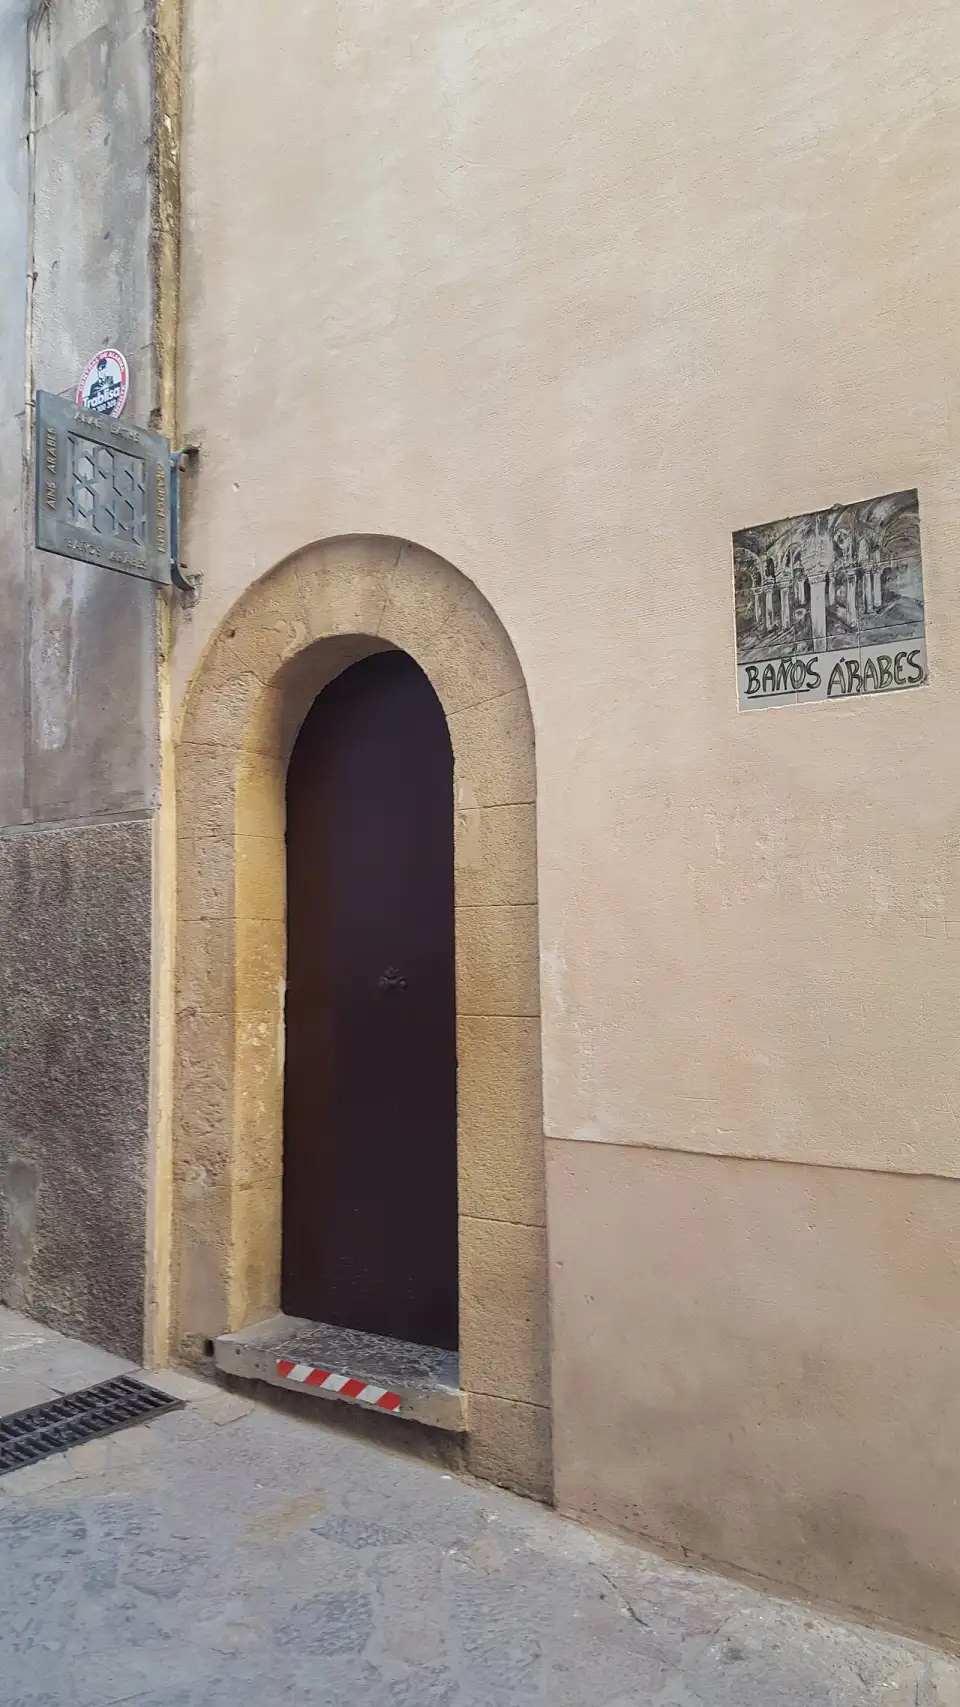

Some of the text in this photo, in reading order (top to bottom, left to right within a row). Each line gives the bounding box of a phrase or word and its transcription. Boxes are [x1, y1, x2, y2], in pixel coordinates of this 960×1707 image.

[83, 387, 120, 409] Trablisa
[743, 650, 924, 695] BAÑOS ÁRABES
